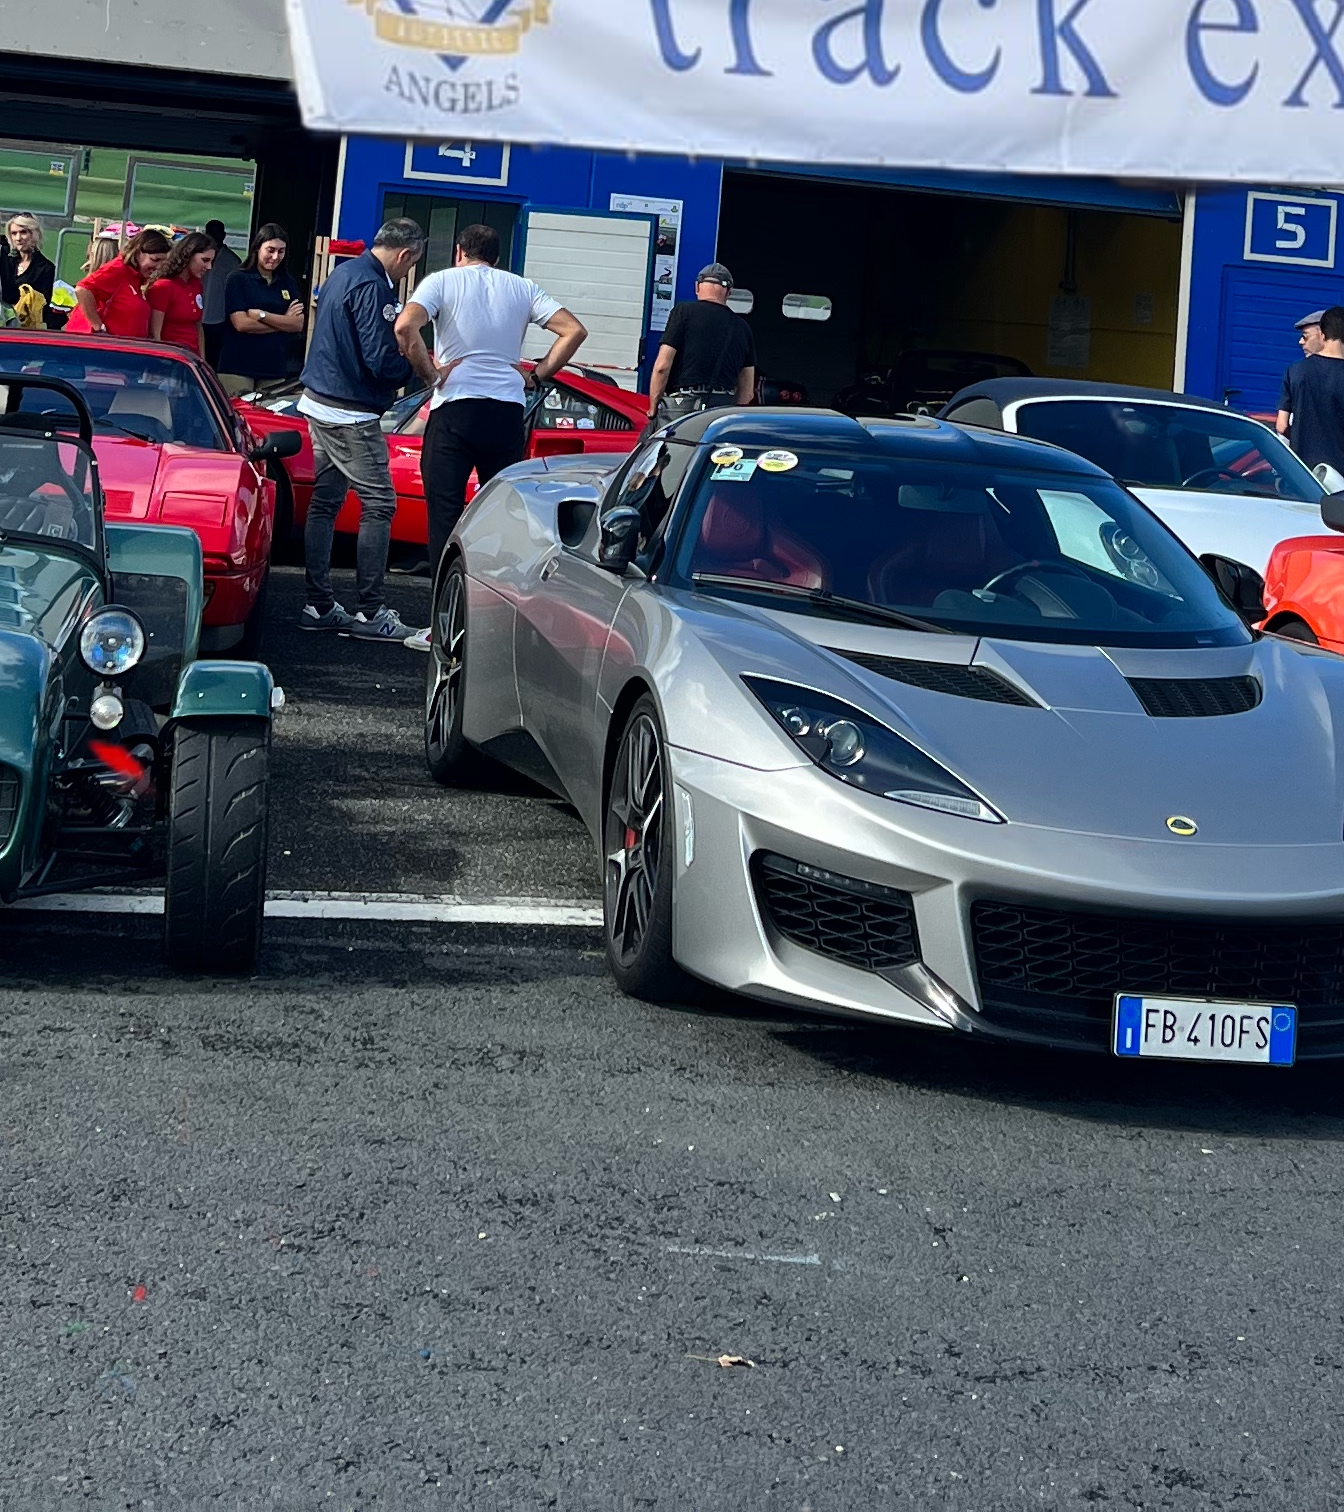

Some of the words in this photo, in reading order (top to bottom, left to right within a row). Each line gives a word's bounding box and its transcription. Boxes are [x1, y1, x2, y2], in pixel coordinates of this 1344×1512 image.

[384, 65, 520, 115] ANGELS
[1276, 205, 1306, 248] 5
[380, 623, 396, 636] N
